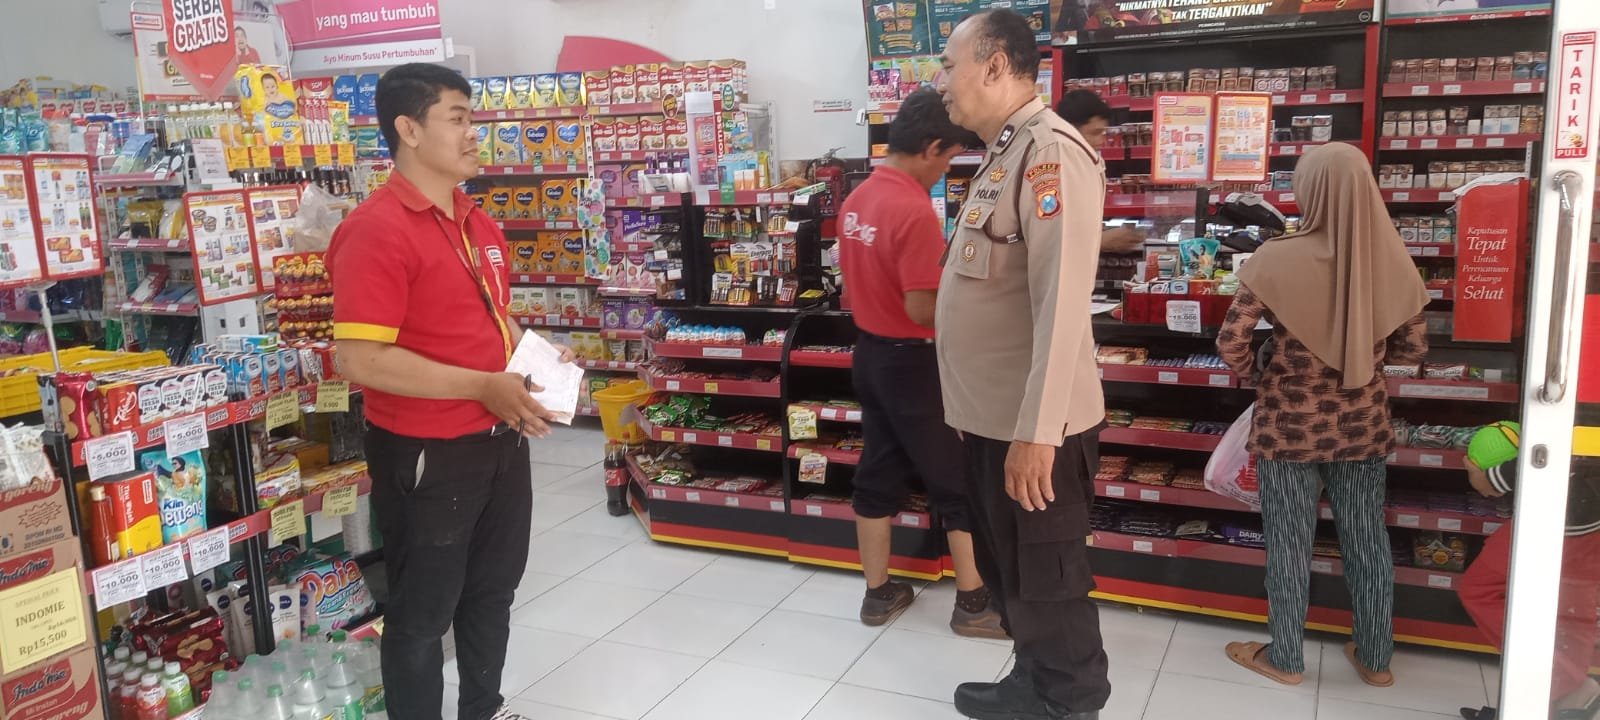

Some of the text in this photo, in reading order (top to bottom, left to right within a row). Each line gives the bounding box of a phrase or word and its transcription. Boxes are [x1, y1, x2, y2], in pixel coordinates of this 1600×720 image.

[174, 0, 223, 21] SERBA
[316, 2, 436, 31] yang mau tumbuh
[1171, 11, 1187, 20] TAK
[174, 16, 227, 49] GRATIS
[323, 55, 337, 64] Ayo
[338, 53, 362, 62] Minum
[362, 51, 381, 60] Susu
[1567, 49, 1584, 127] TARIK
[715, 111, 725, 162] lkomsel
[1557, 149, 1585, 157] PULL
[1467, 226, 1508, 236] Keputusan
[1466, 236, 1507, 254] Tepat
[1473, 255, 1499, 263] Untuk
[1462, 264, 1509, 273] Perencanaan
[1468, 274, 1503, 284] Keluarga
[1463, 285, 1505, 300] Sehat
[164, 394, 182, 402] FRESH
[163, 498, 184, 510] Klin
[160, 500, 203, 526] ewang
[1239, 531, 1264, 540] DAIRY
[296, 558, 362, 607] Daia
[15, 600, 66, 627] INDOMIE
[19, 629, 68, 656] Rp15,500
